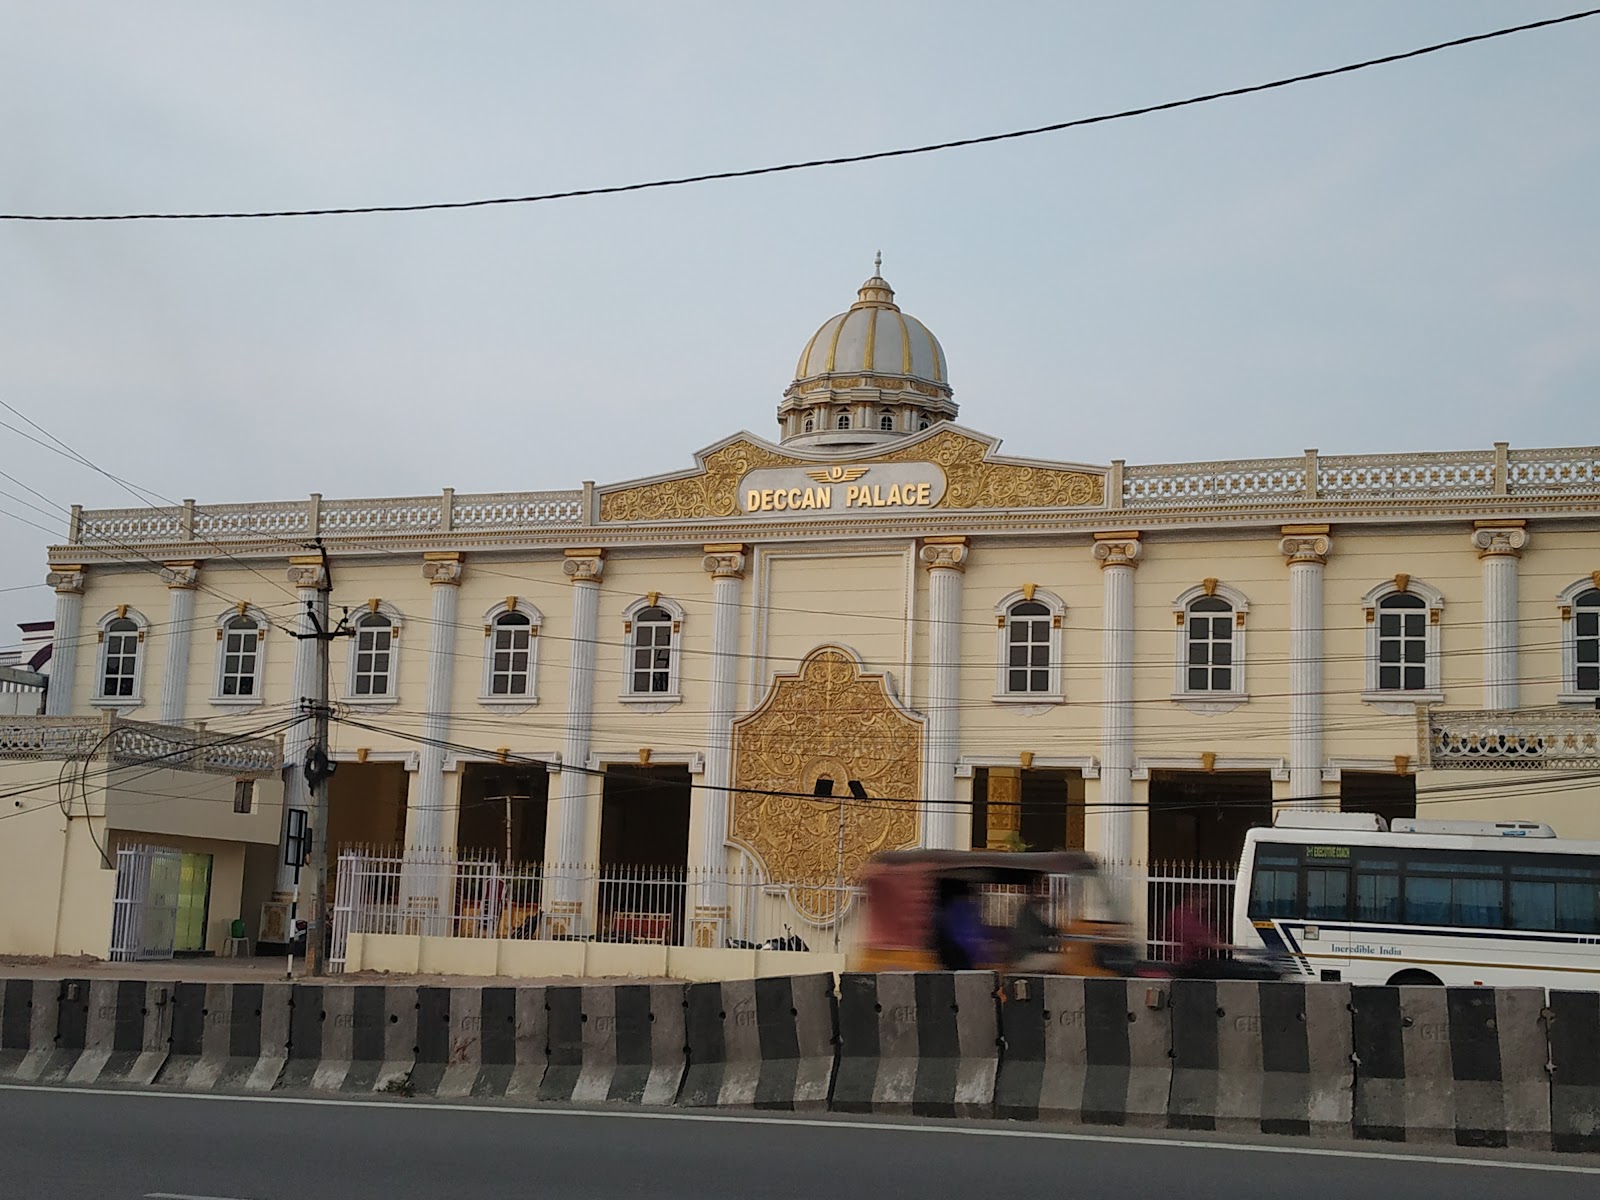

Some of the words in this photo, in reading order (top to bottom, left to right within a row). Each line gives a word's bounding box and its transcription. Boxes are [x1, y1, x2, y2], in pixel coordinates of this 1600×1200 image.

[747, 486, 832, 512] DECCAN
[846, 482, 931, 507] PALACE
[1331, 943, 1375, 955] Incredible
[1379, 945, 1402, 956] India
